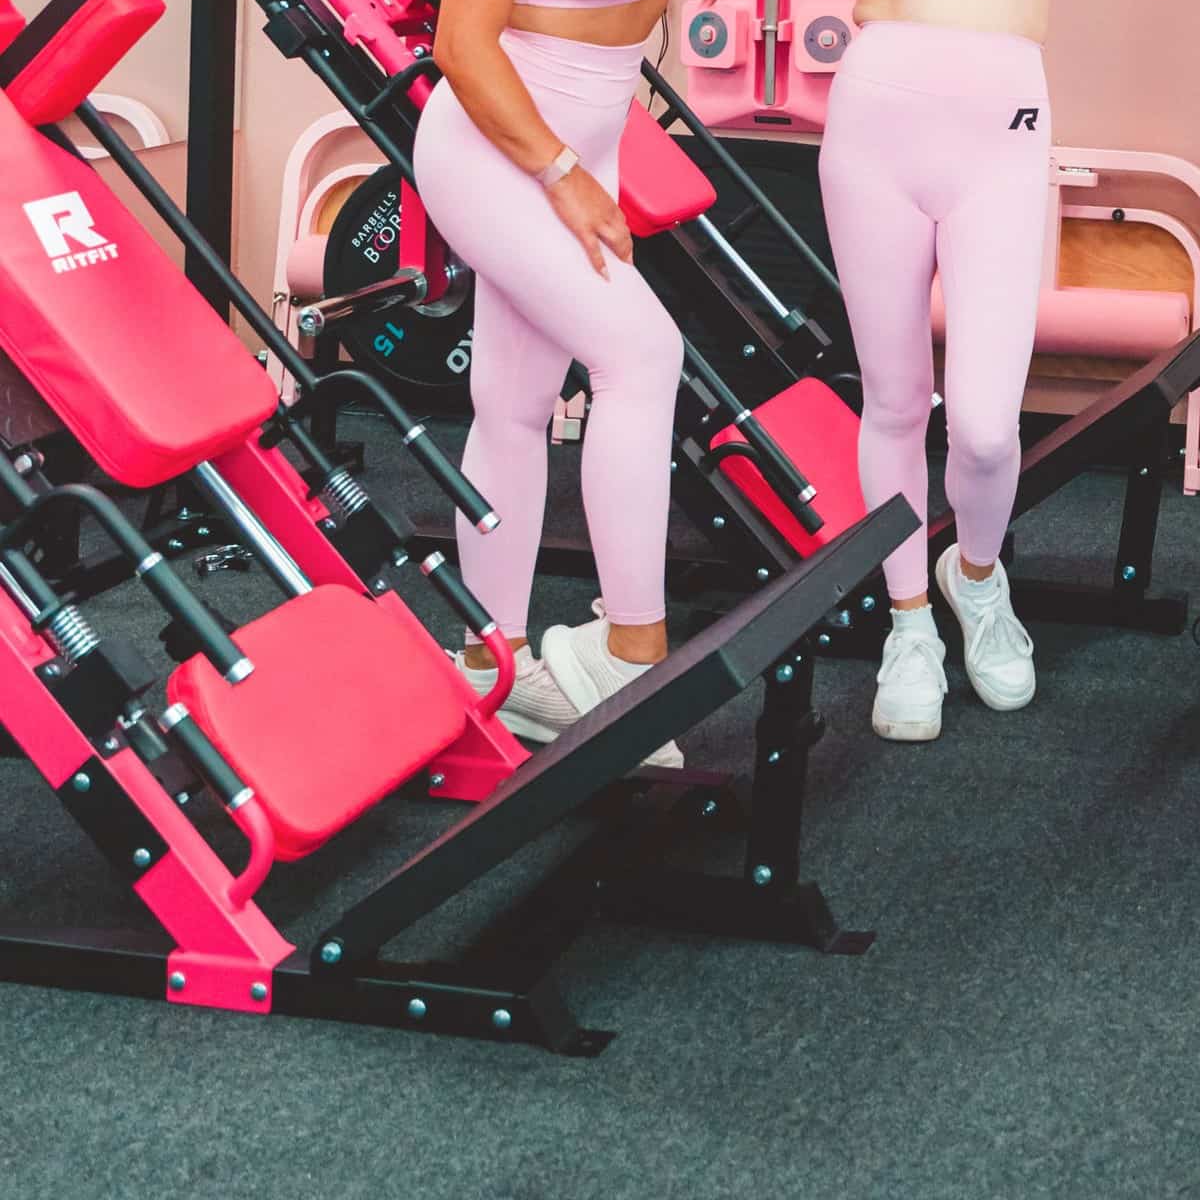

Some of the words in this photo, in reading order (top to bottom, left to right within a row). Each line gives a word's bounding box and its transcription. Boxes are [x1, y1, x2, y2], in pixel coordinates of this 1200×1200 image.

[22, 190, 109, 259] R
[351, 191, 397, 248] BARBELLS
[363, 204, 402, 264] BOOB
[50, 243, 119, 275] RITFIT
[373, 321, 405, 358] 15
